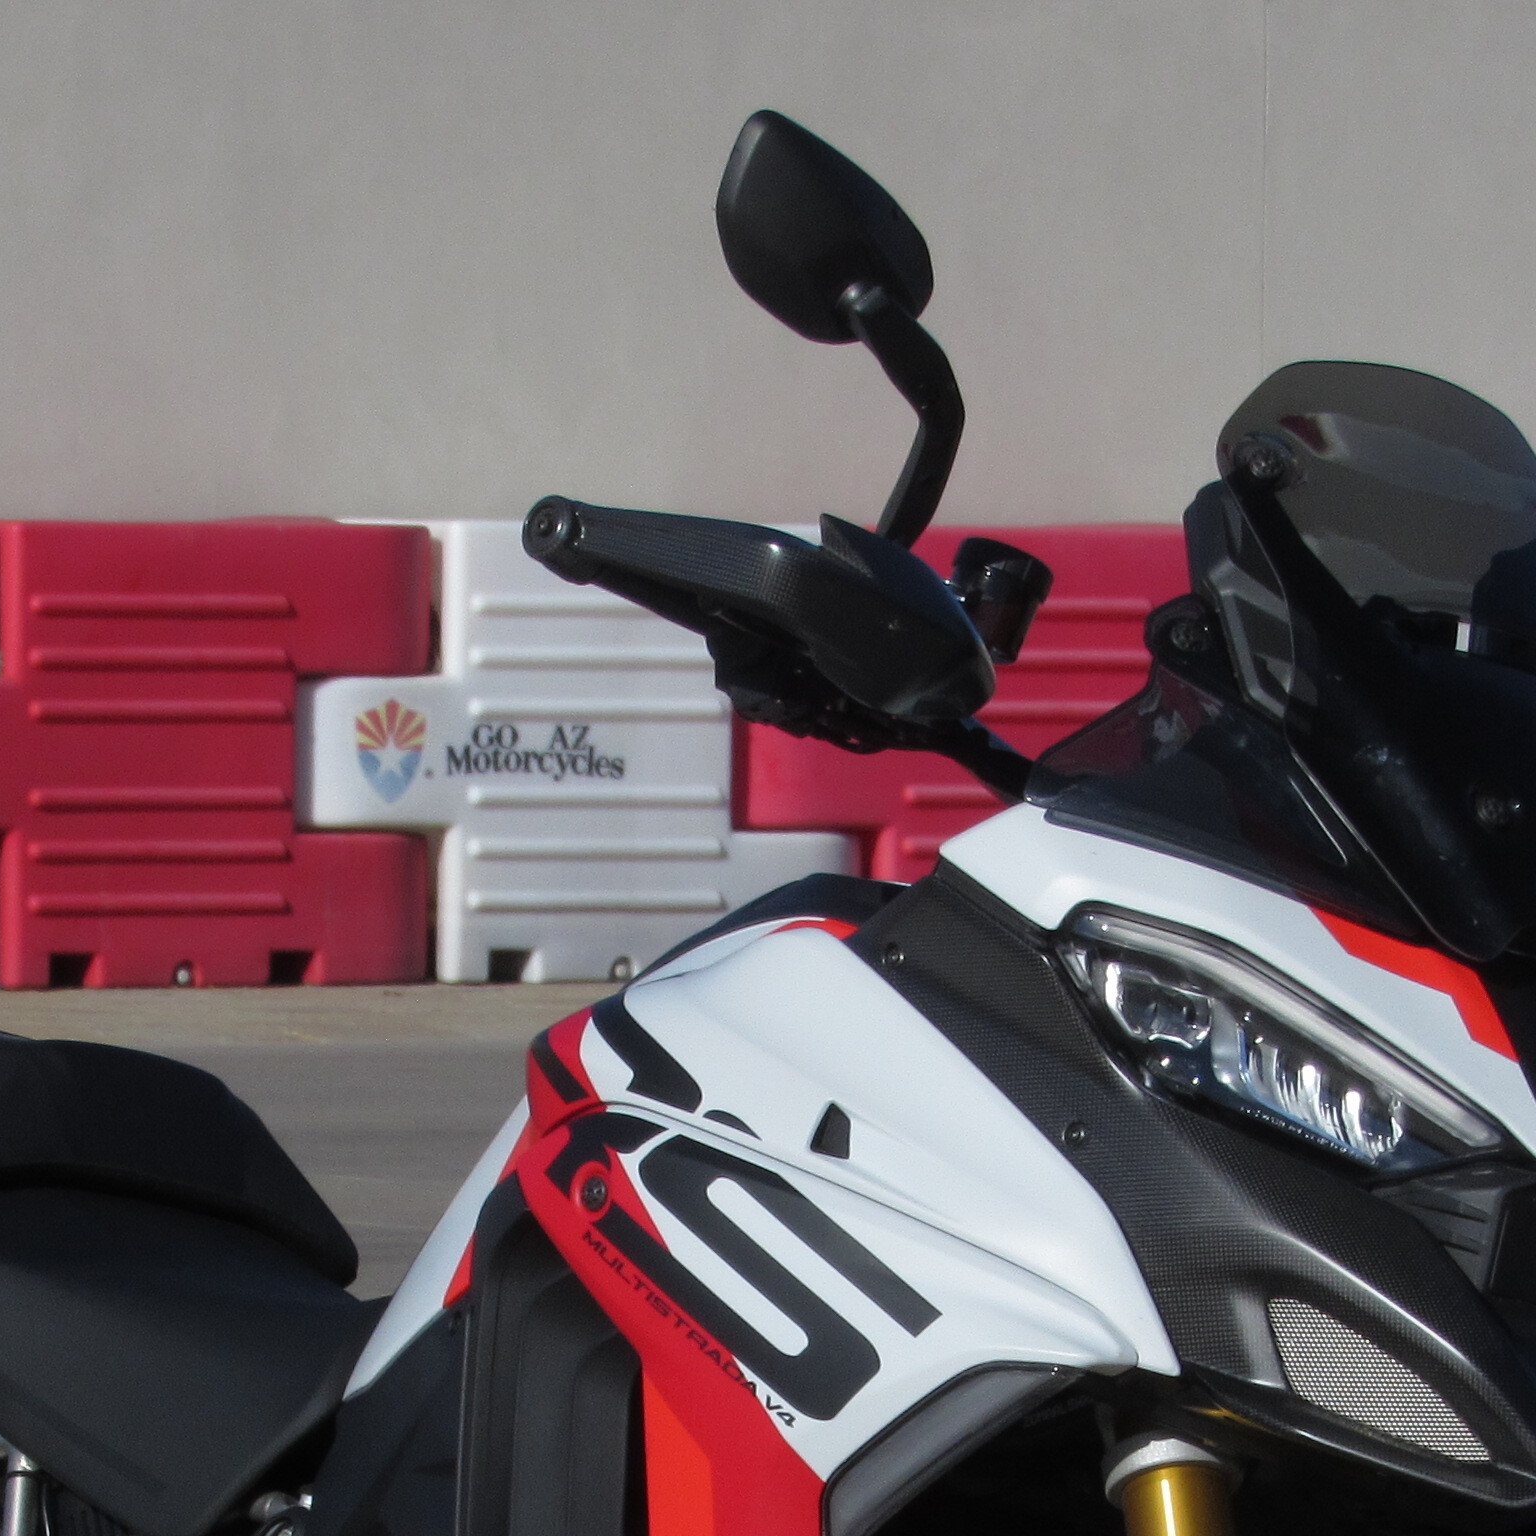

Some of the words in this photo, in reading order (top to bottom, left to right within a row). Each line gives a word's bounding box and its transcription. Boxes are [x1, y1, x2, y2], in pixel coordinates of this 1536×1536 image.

[471, 723, 519, 750] GO
[548, 724, 591, 750] AZ
[446, 744, 626, 781] Motorcycles
[580, 1230, 760, 1399] MULTISTRADA
[763, 1394, 798, 1429] V4
